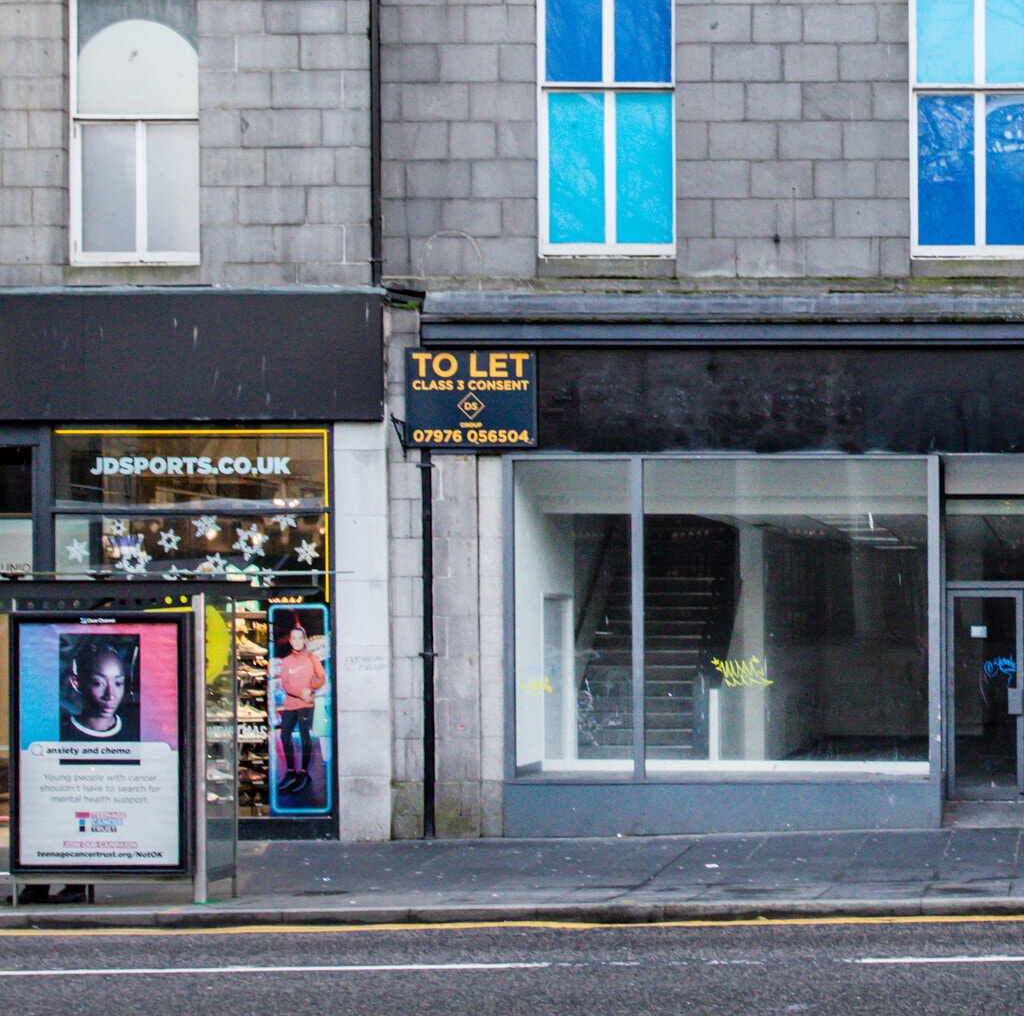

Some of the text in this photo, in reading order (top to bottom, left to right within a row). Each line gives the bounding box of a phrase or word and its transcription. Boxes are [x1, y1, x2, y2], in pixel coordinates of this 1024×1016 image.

[411, 352, 530, 378] TO LET
[411, 379, 530, 391] CLASS 3 CONSENT
[463, 401, 479, 411] DS
[412, 429, 530, 443] 07976 056504
[90, 456, 291, 475] JDSPORTS.CO.UK
[46, 747, 131, 755] anxiety and chemo
[43, 773, 72, 782] Young
[39, 784, 80, 792] shouldn't
[50, 795, 82, 803] mental
[84, 795, 111, 803] health
[37, 850, 163, 859] teenagecancertrust.org/NotOK
